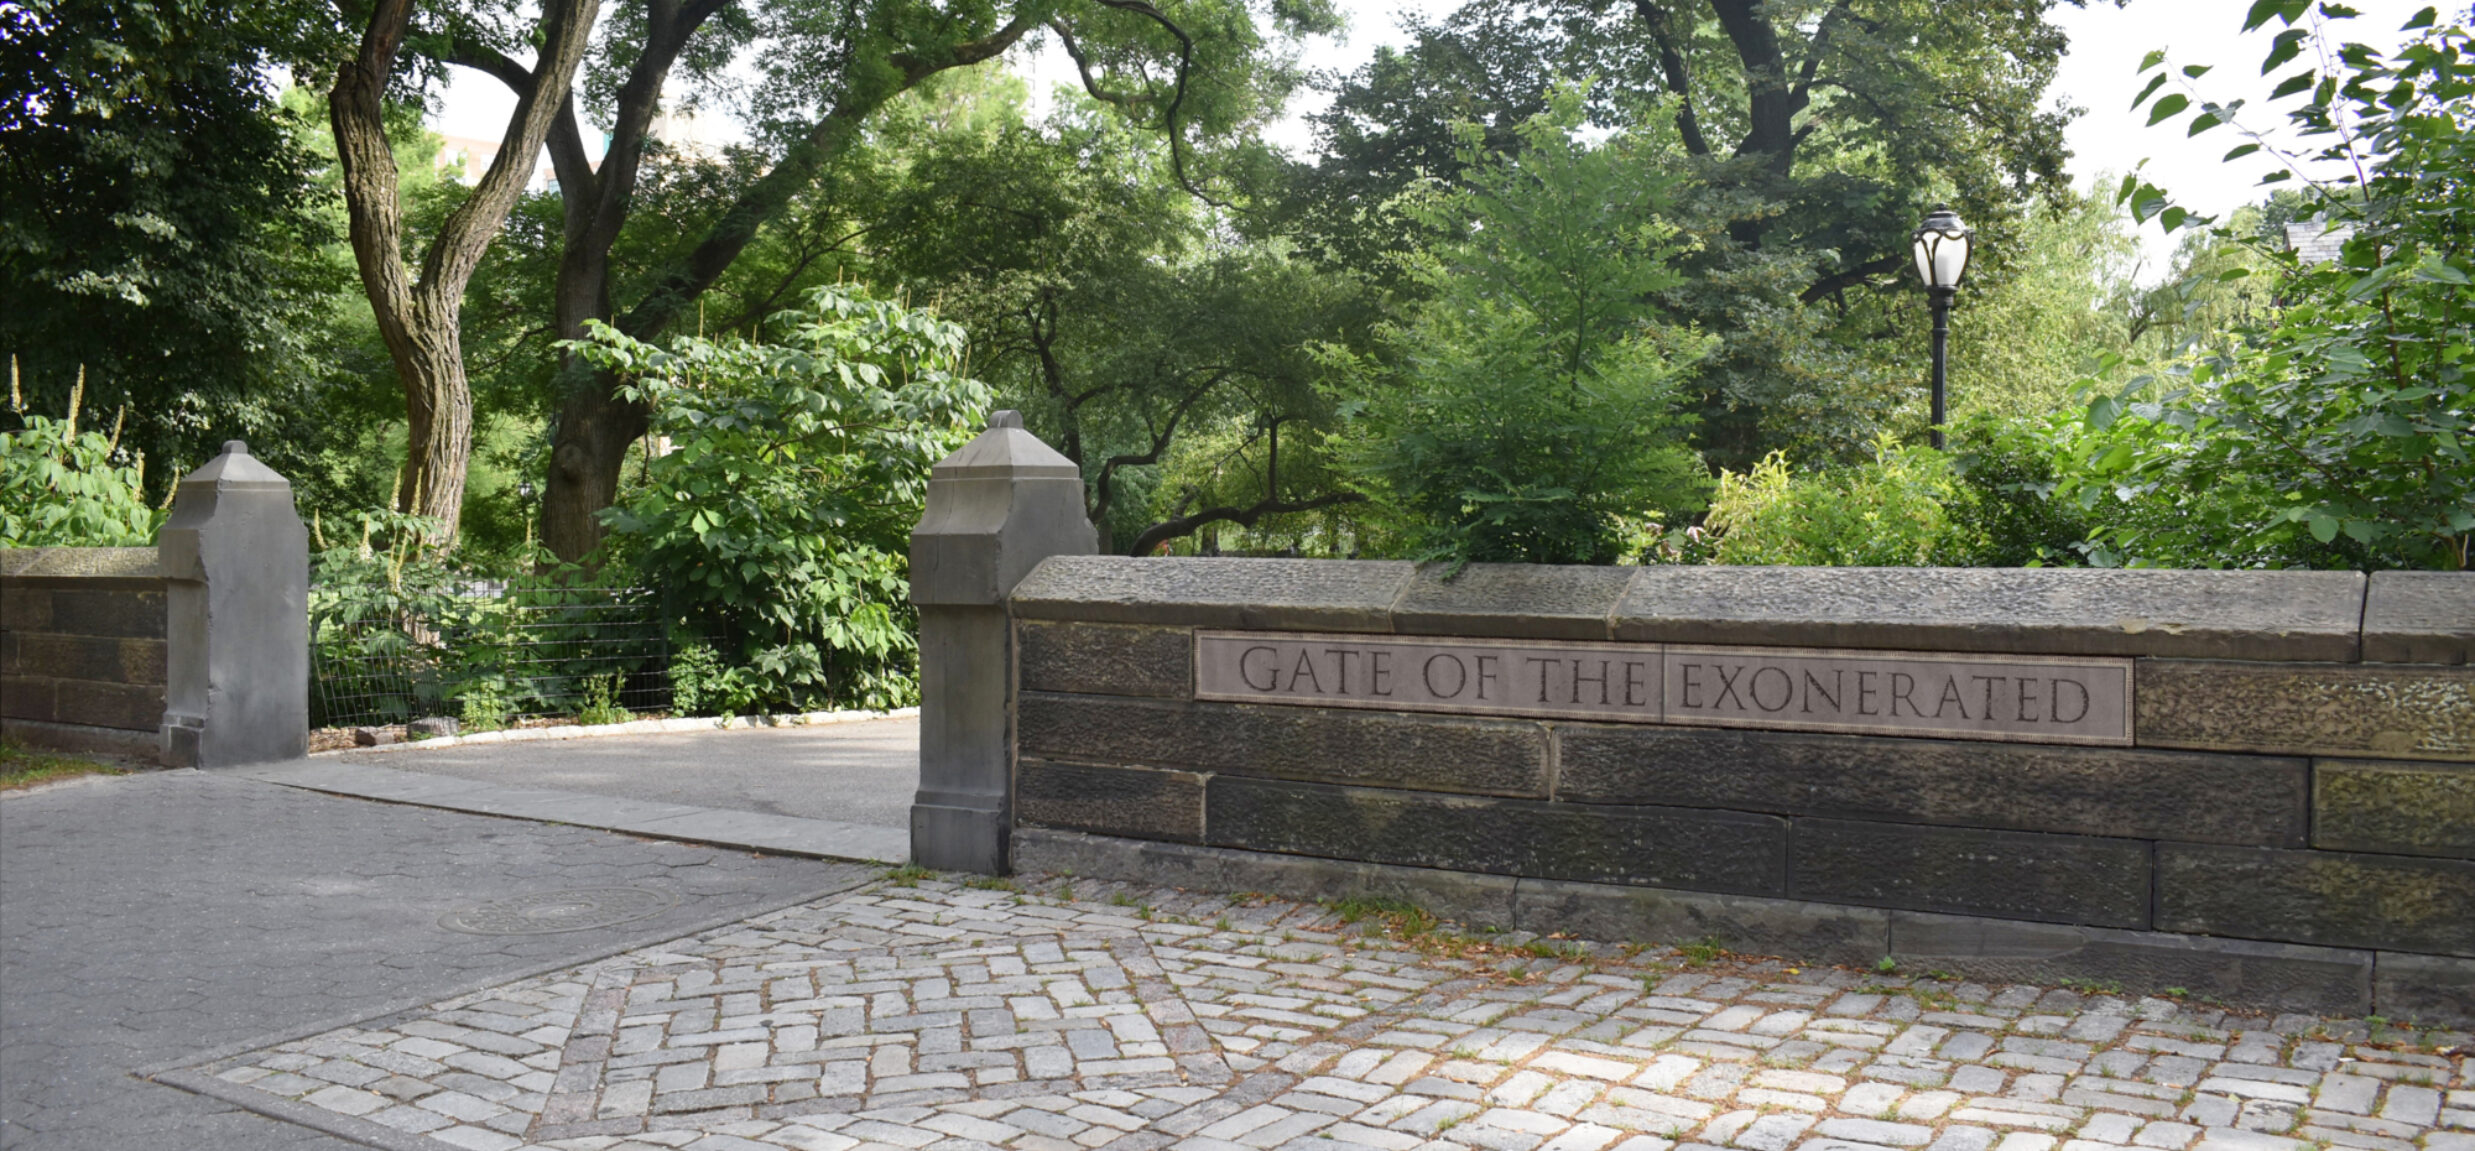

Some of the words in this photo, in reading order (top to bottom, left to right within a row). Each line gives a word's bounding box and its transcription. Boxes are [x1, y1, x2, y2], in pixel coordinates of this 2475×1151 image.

[1239, 646, 1392, 697] GATE
[1422, 653, 1498, 700] OF
[1526, 657, 1647, 706] THE
[1679, 663, 2090, 724] EXONERATED
